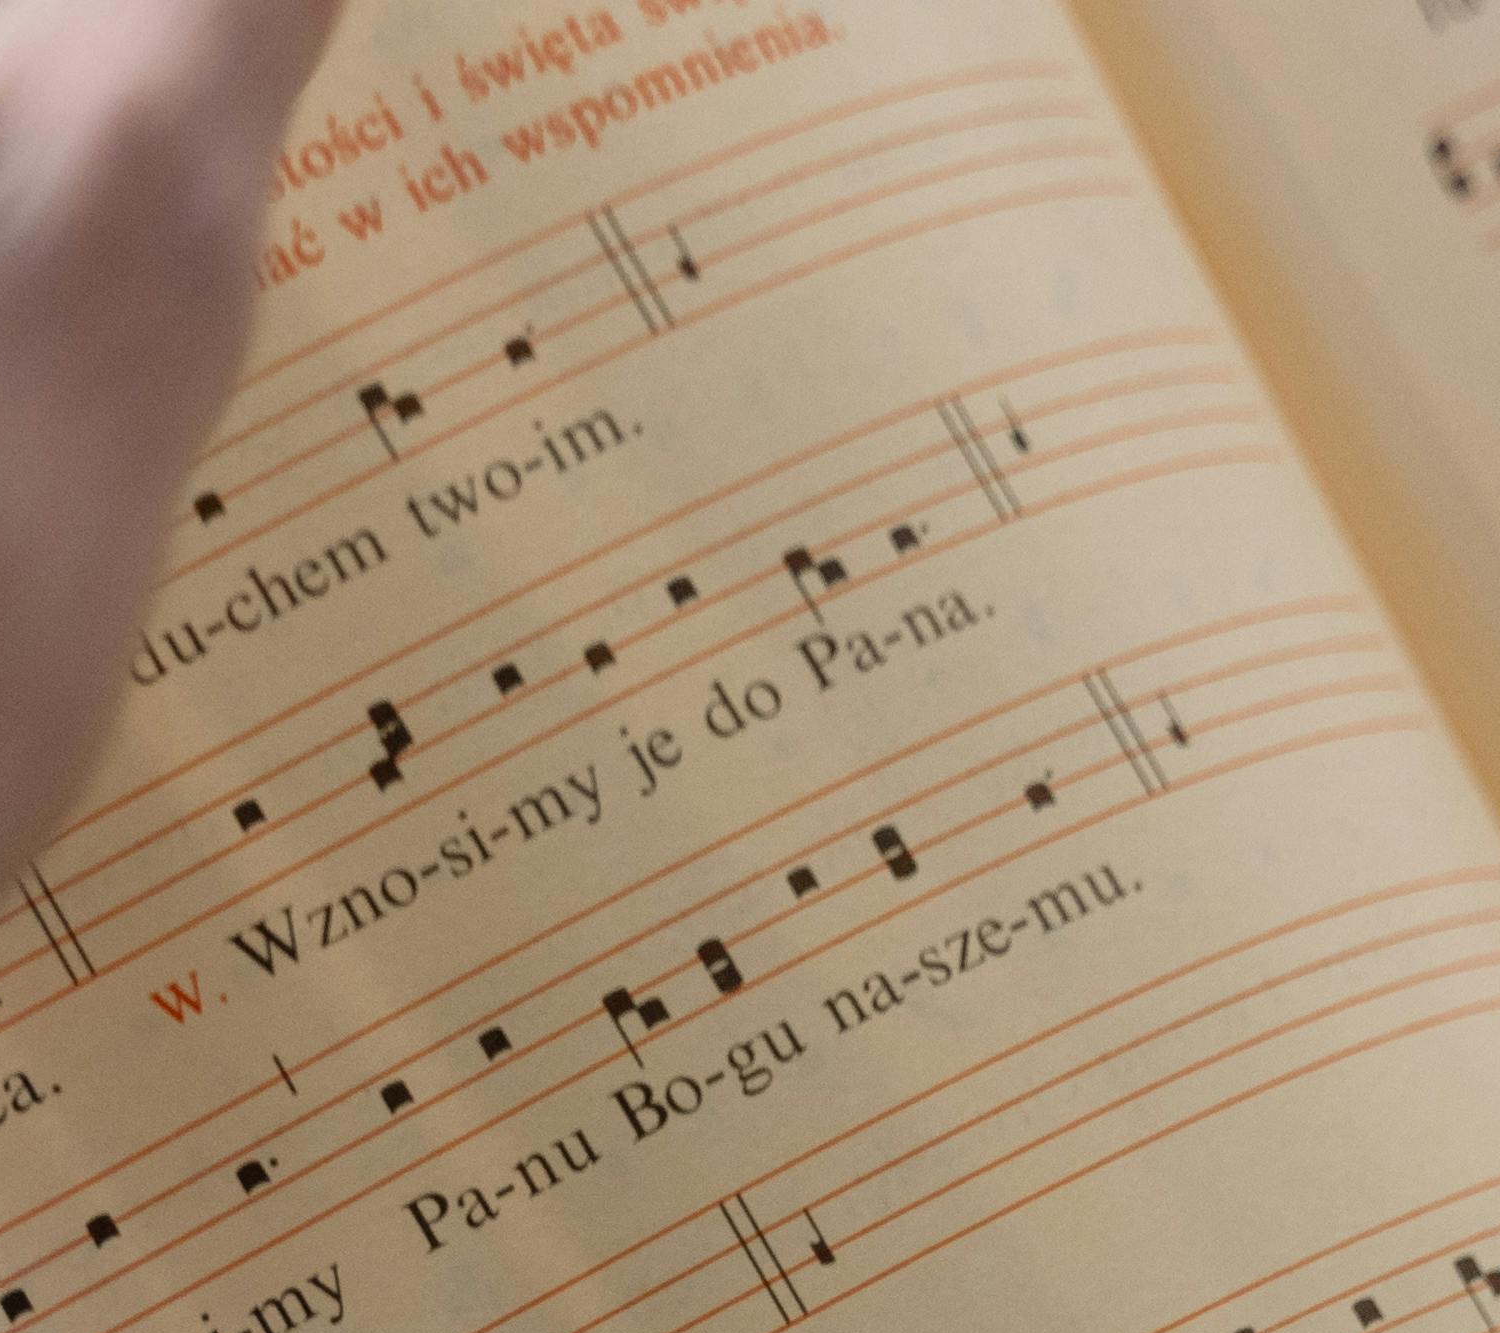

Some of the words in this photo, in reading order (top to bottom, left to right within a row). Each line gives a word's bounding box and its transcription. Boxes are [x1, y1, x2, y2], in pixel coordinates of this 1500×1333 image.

[338, 196, 383, 242] w
[406, 146, 488, 213] ich
[501, 5, 845, 164] wspomnienia.
[420, 74, 442, 121] i
[457, 8, 623, 103] święta
[130, 526, 387, 686] du-chem
[406, 406, 644, 539] two-im.
[227, 764, 604, 977] Wzno-si-my
[619, 722, 683, 796] je
[704, 678, 783, 743] do
[797, 590, 994, 691] Pa-na.
[404, 1129, 601, 1252] Pa-nu
[611, 1019, 806, 1144] Bo-gu
[823, 863, 1144, 1034] na-sze-mu.
